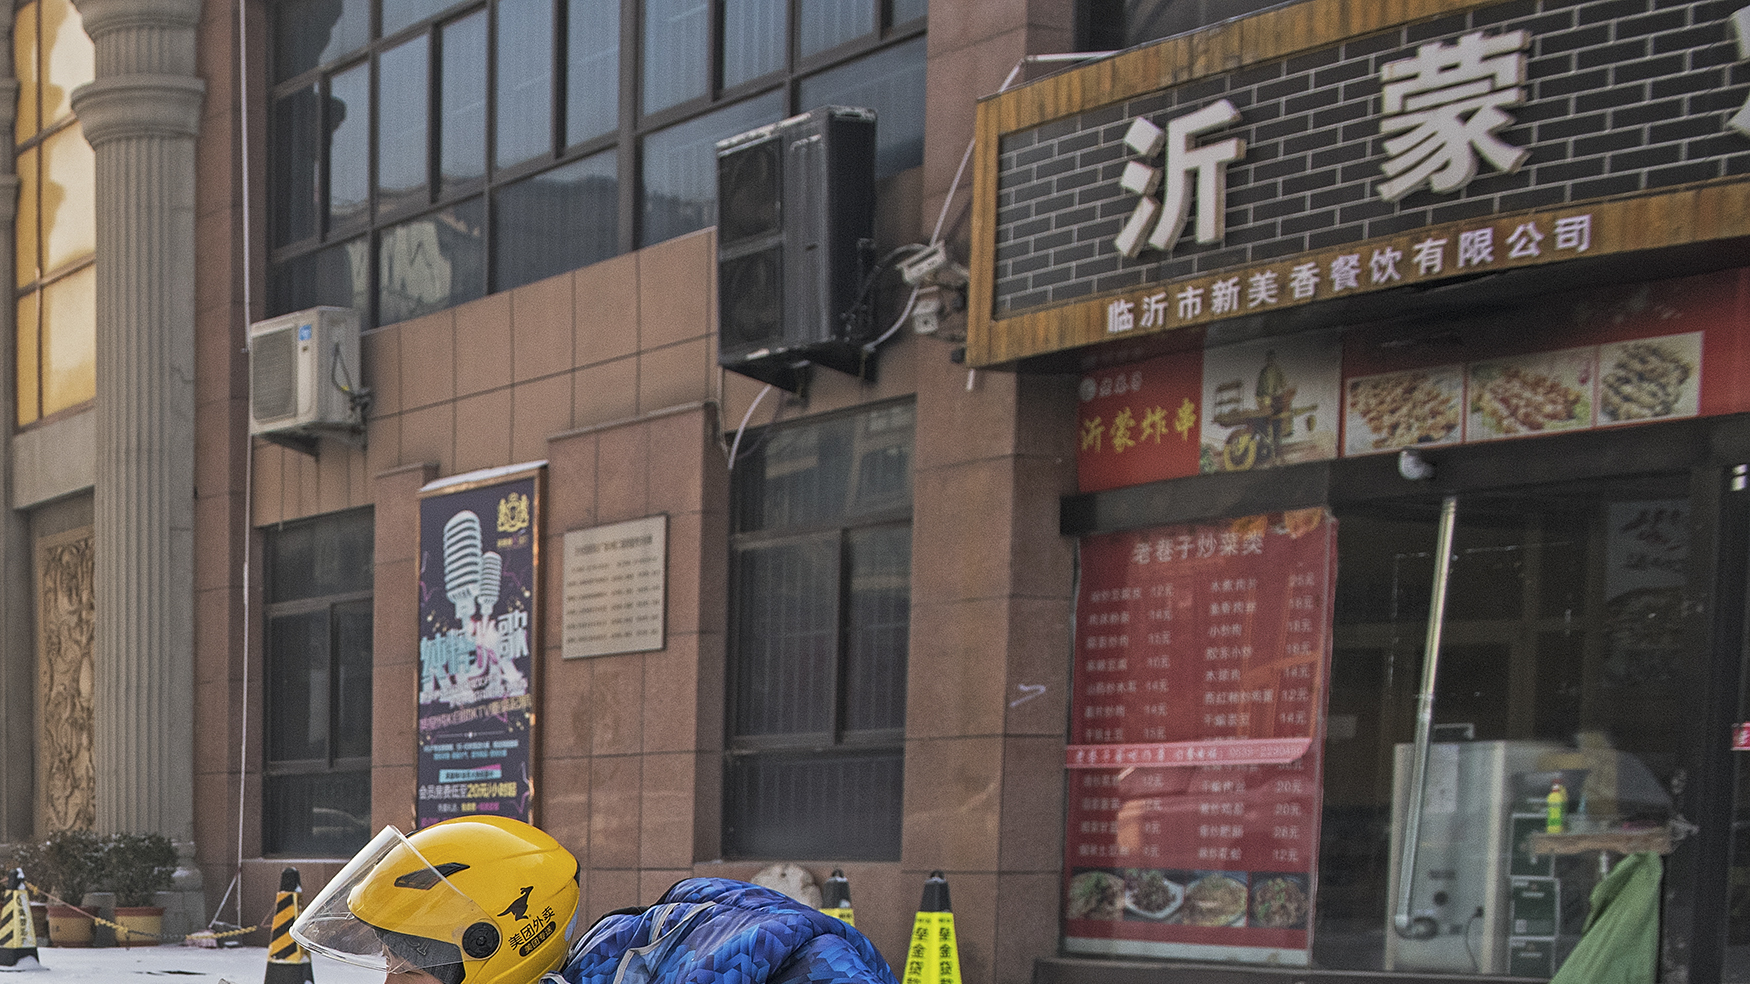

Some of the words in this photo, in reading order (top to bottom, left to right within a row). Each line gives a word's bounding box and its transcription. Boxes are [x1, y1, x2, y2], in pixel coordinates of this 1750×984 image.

[1107, 214, 1592, 333] 临沂市新美香餐饮有限公司
[1079, 397, 1197, 454] 沂蒙炸串
[508, 906, 555, 951] 美团外卖
